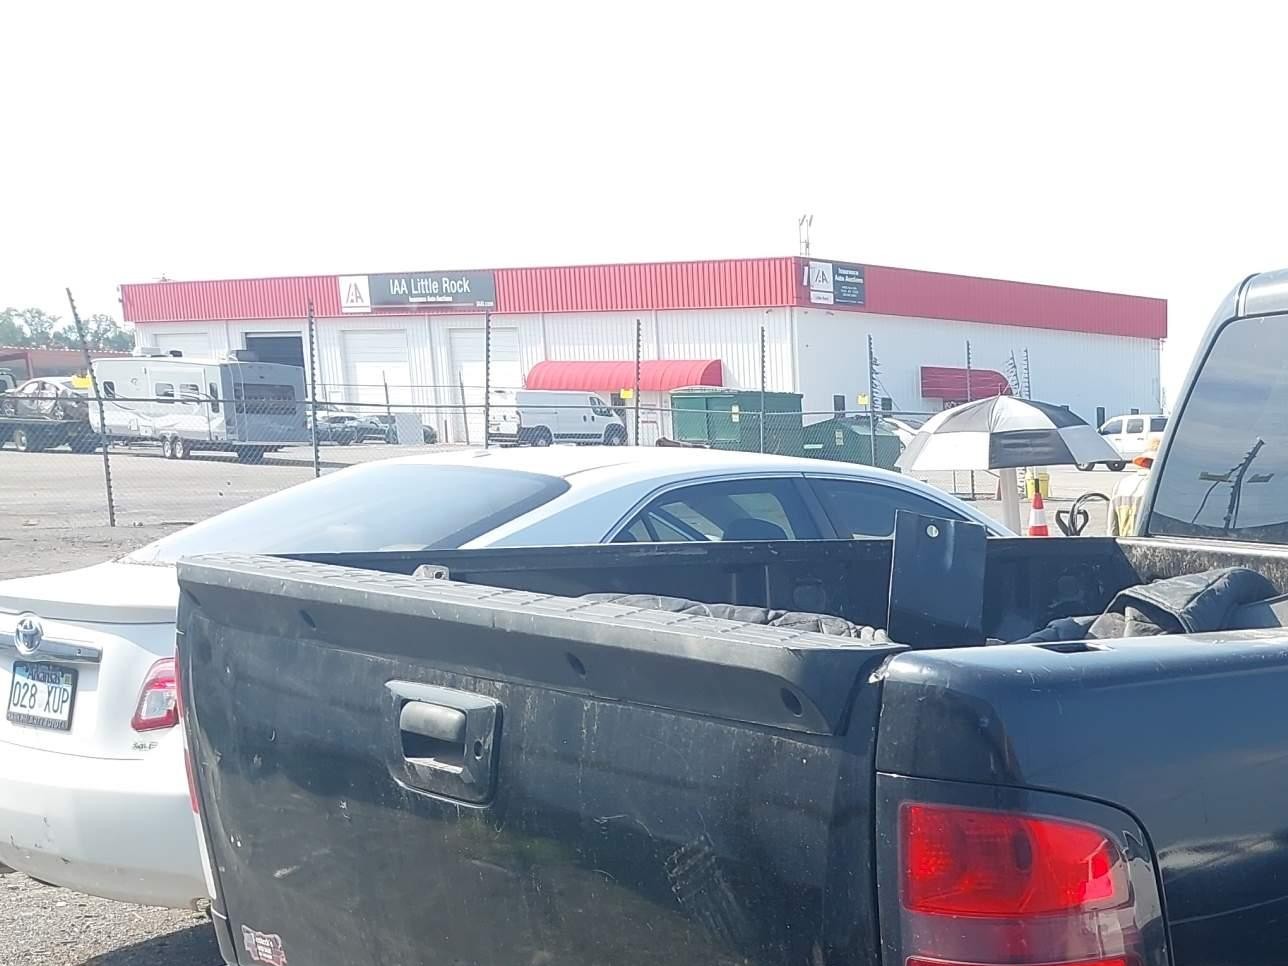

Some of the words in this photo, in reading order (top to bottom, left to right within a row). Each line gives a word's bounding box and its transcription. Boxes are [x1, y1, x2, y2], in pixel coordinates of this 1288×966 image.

[389, 279, 408, 294] IAA
[411, 277, 439, 295] Little
[442, 276, 471, 293] Rock
[43, 685, 69, 714] XUP
